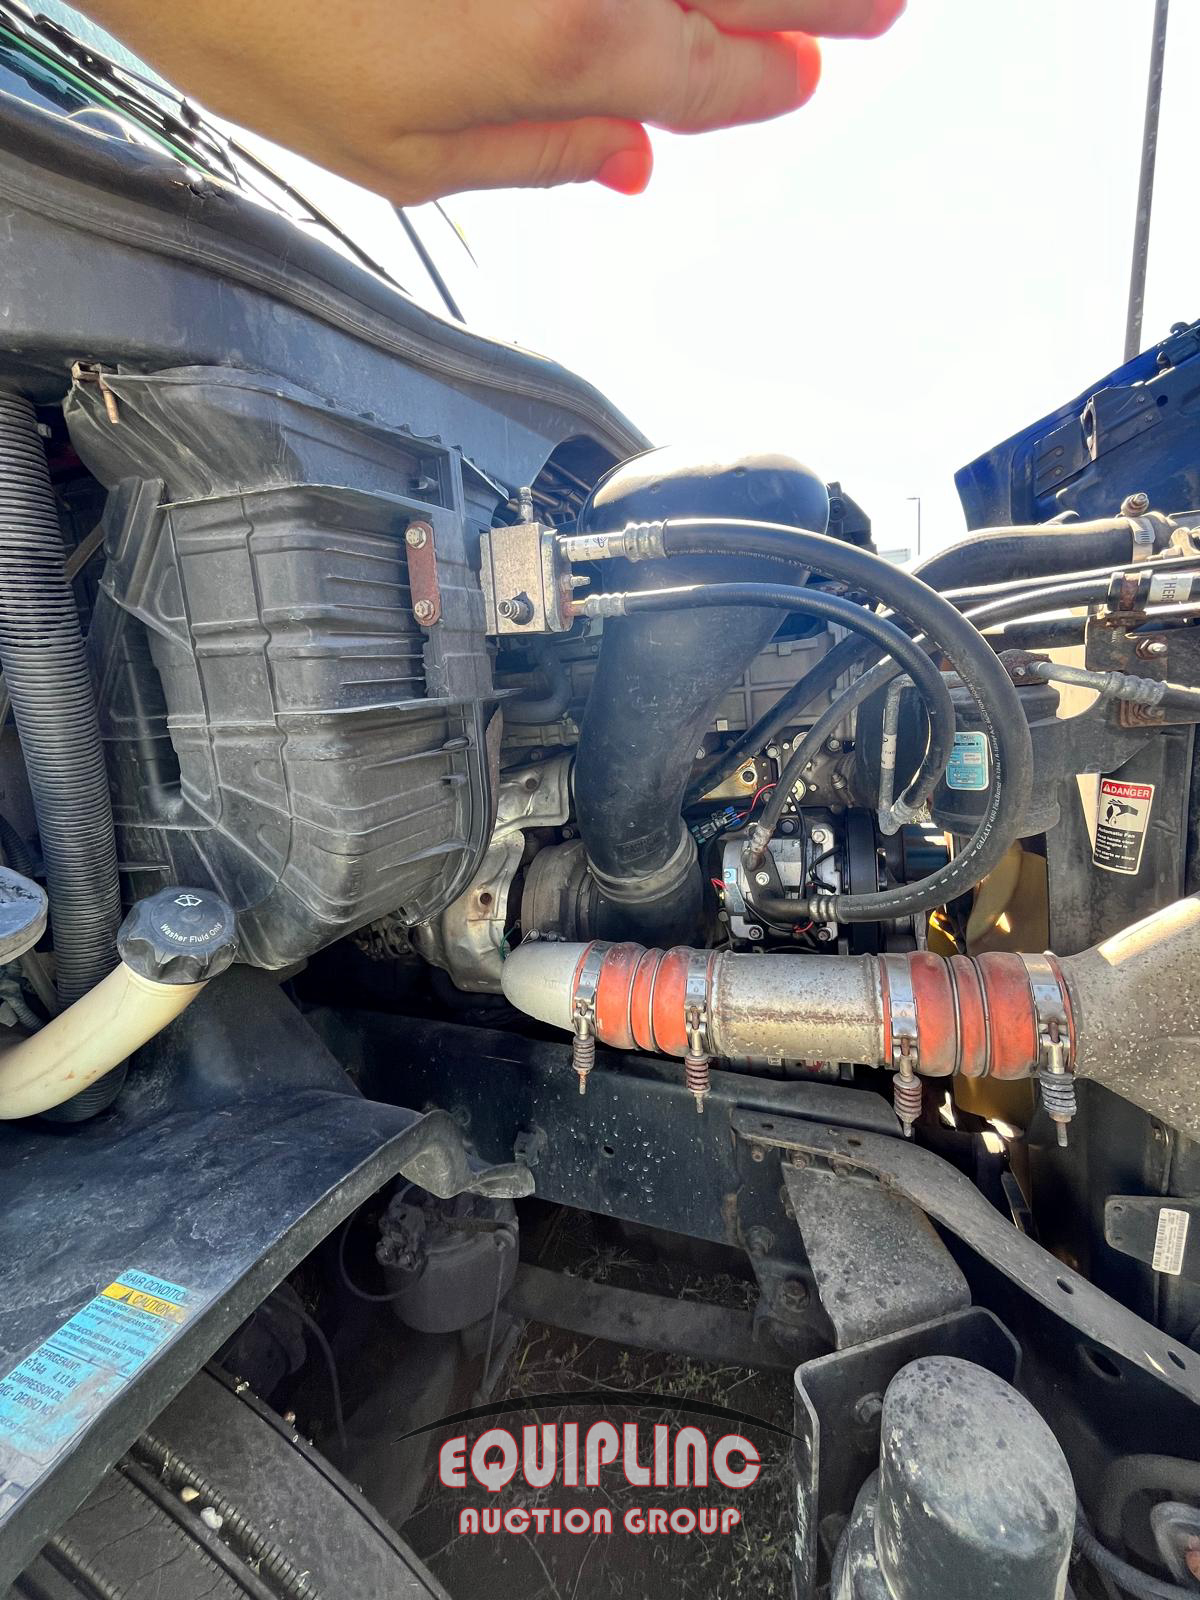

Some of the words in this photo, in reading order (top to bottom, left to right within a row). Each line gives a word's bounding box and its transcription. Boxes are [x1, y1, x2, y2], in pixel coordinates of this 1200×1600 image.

[1111, 786, 1150, 797] DANGER
[976, 821, 993, 850] GALAXY
[160, 923, 188, 943] Washer
[189, 931, 210, 943] Fluid
[209, 922, 223, 936] Only
[128, 1275, 147, 1287] AIR
[132, 1294, 171, 1315] CAUTION
[9, 1371, 54, 1397] COMPRESSOR
[12, 1391, 44, 1411] DENSO
